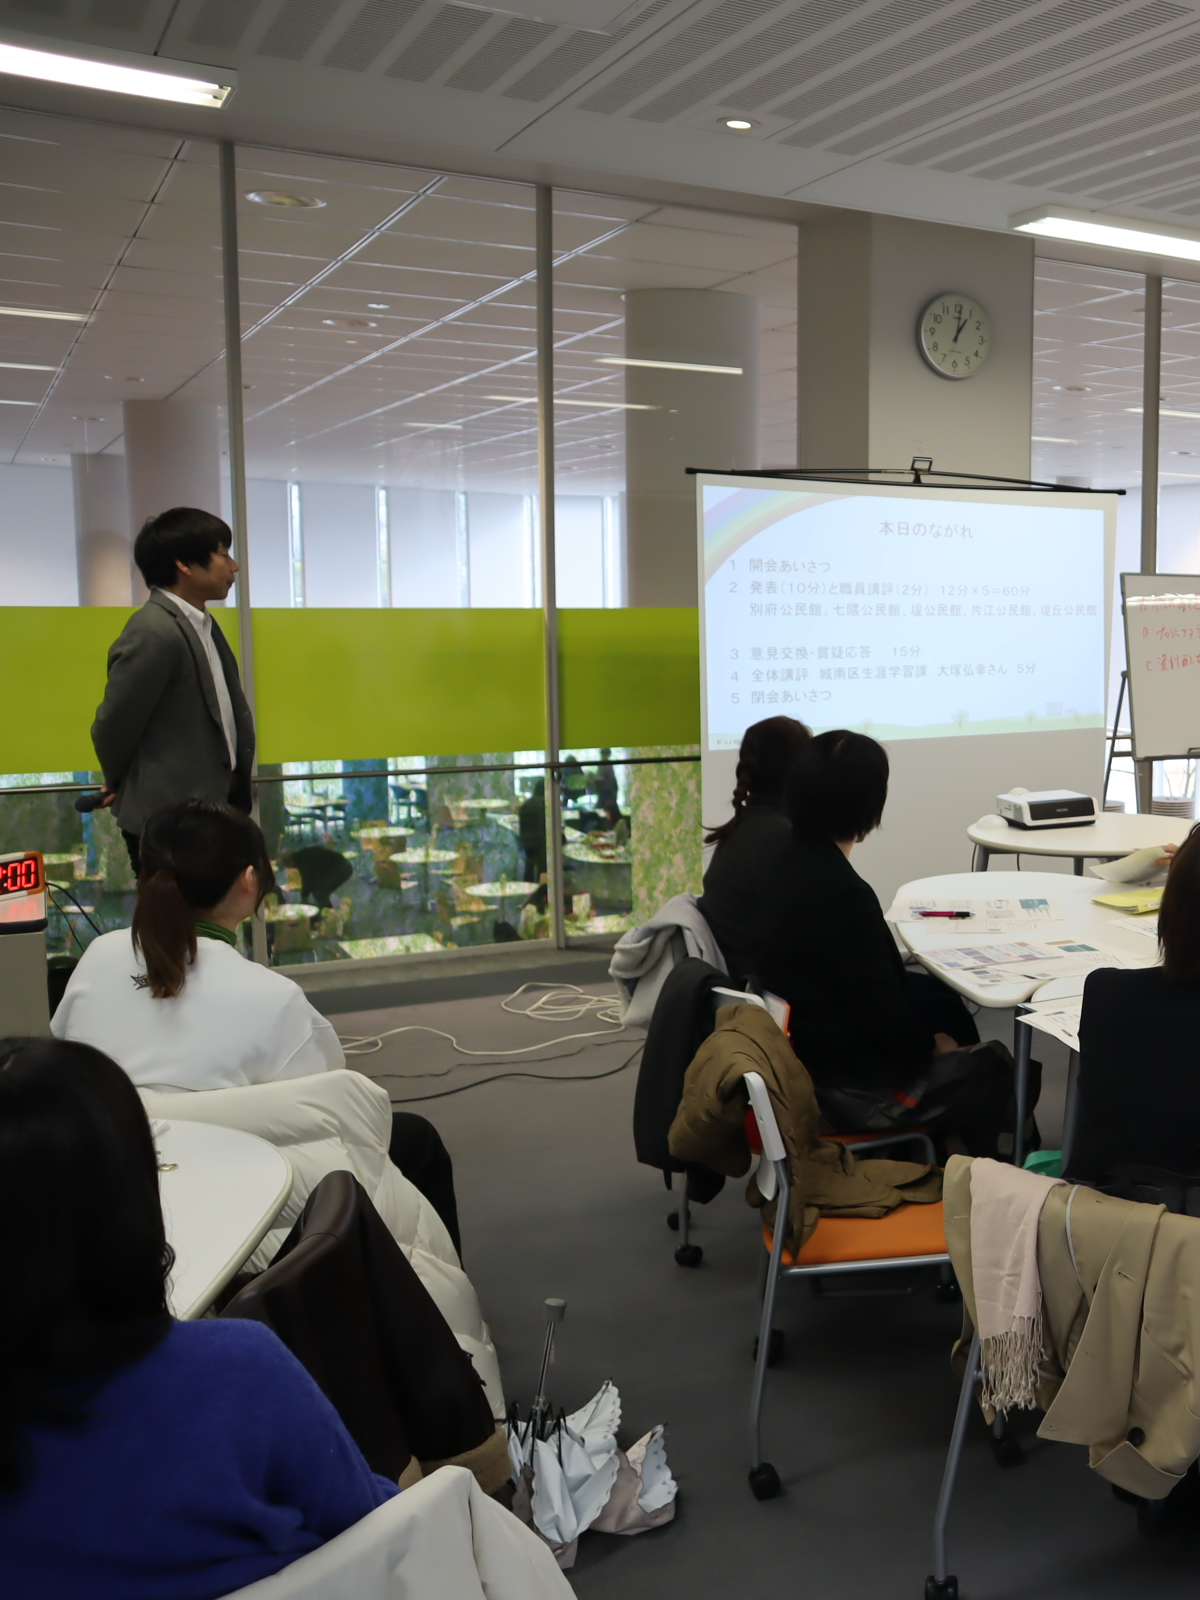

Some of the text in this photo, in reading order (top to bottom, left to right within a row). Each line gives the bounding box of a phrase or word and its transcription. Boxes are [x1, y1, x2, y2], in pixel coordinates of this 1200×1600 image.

[943, 305, 949, 315] 11
[933, 313, 942, 324] 10
[975, 320, 982, 331] 2
[929, 327, 936, 337] 9
[978, 335, 984, 346] 3
[932, 341, 939, 352] 8
[942, 352, 947, 362] 7
[973, 349, 979, 358] 4
[951, 359, 958, 368] 6
[964, 356, 970, 366] 5
[878, 519, 974, 539] 本日のながれ
[748, 557, 831, 574] 開会あいさつ
[728, 581, 738, 594] 2
[729, 645, 921, 661] 3 意見交換・質疑応答 15分
[730, 662, 1036, 683] 4 全体講評 城南区生涯学習課 大塚弘幸さん 5分
[730, 689, 832, 705] 5 閉会あいさつ
